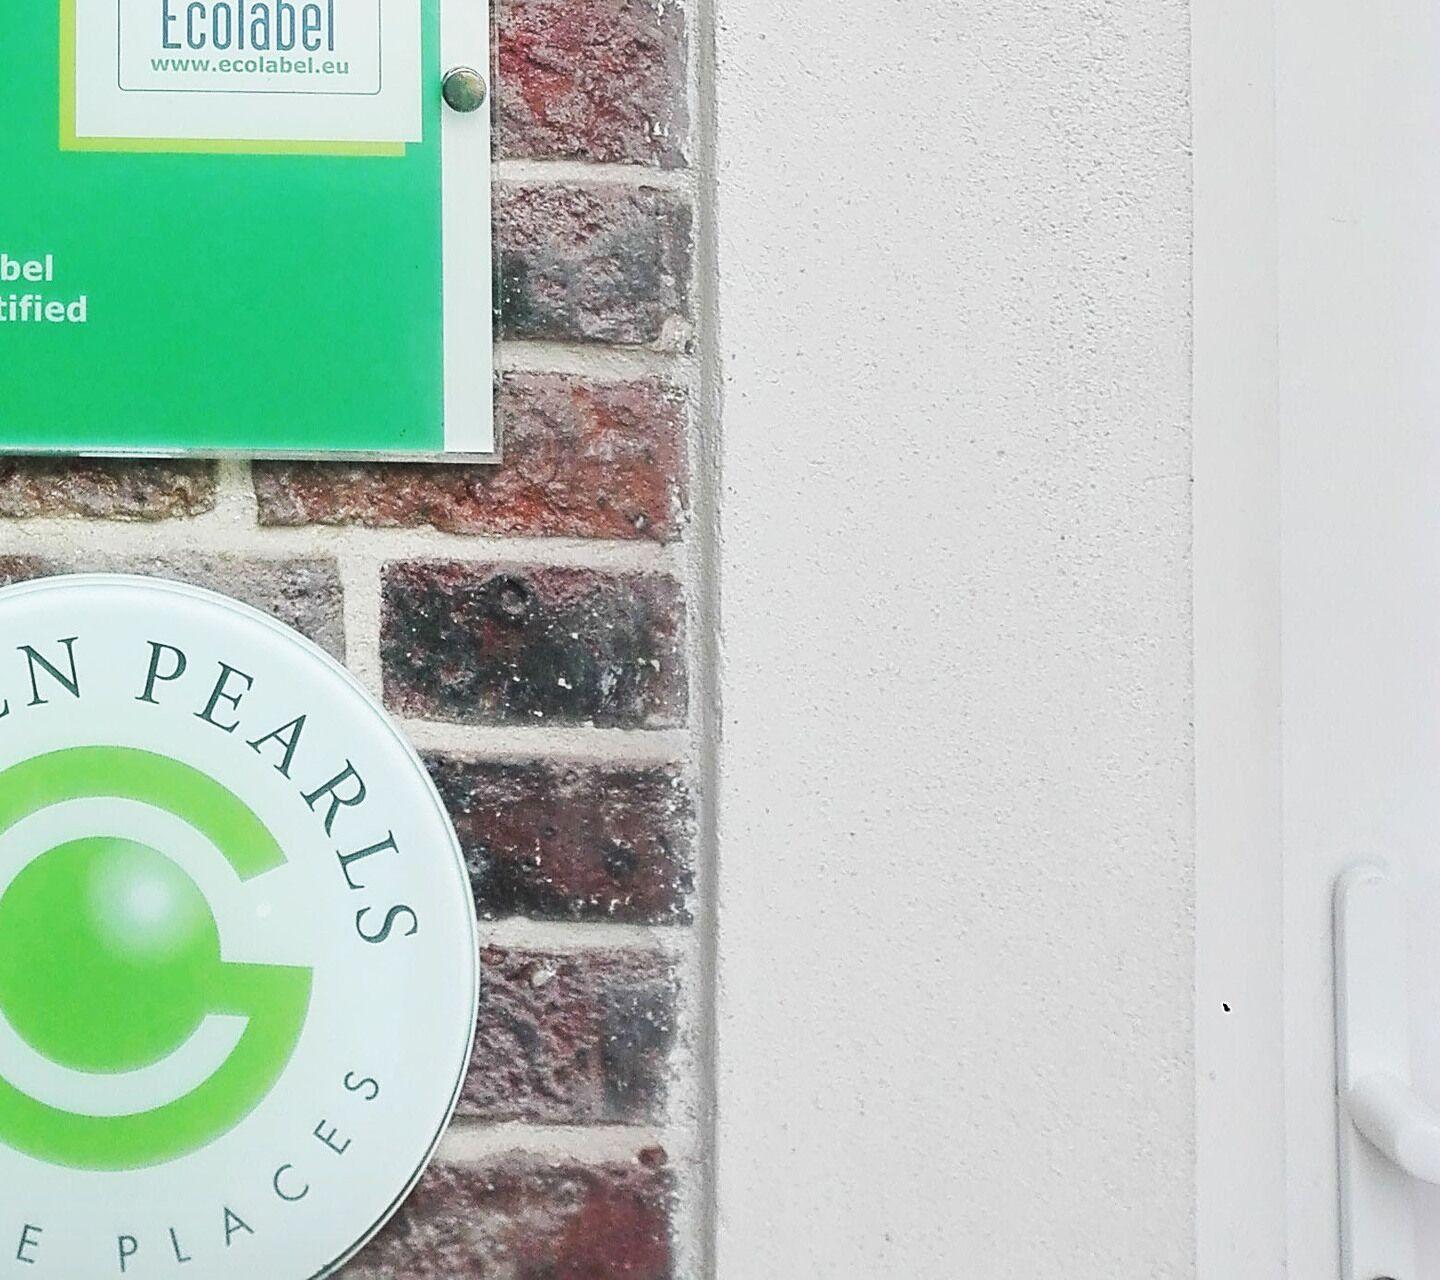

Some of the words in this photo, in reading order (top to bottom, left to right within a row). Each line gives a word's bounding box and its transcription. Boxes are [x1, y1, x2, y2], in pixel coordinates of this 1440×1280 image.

[150, 55, 350, 75] www.ecolabel.eu
[134, 639, 418, 945] PEARLS
[116, 1072, 381, 1272] PLACES
